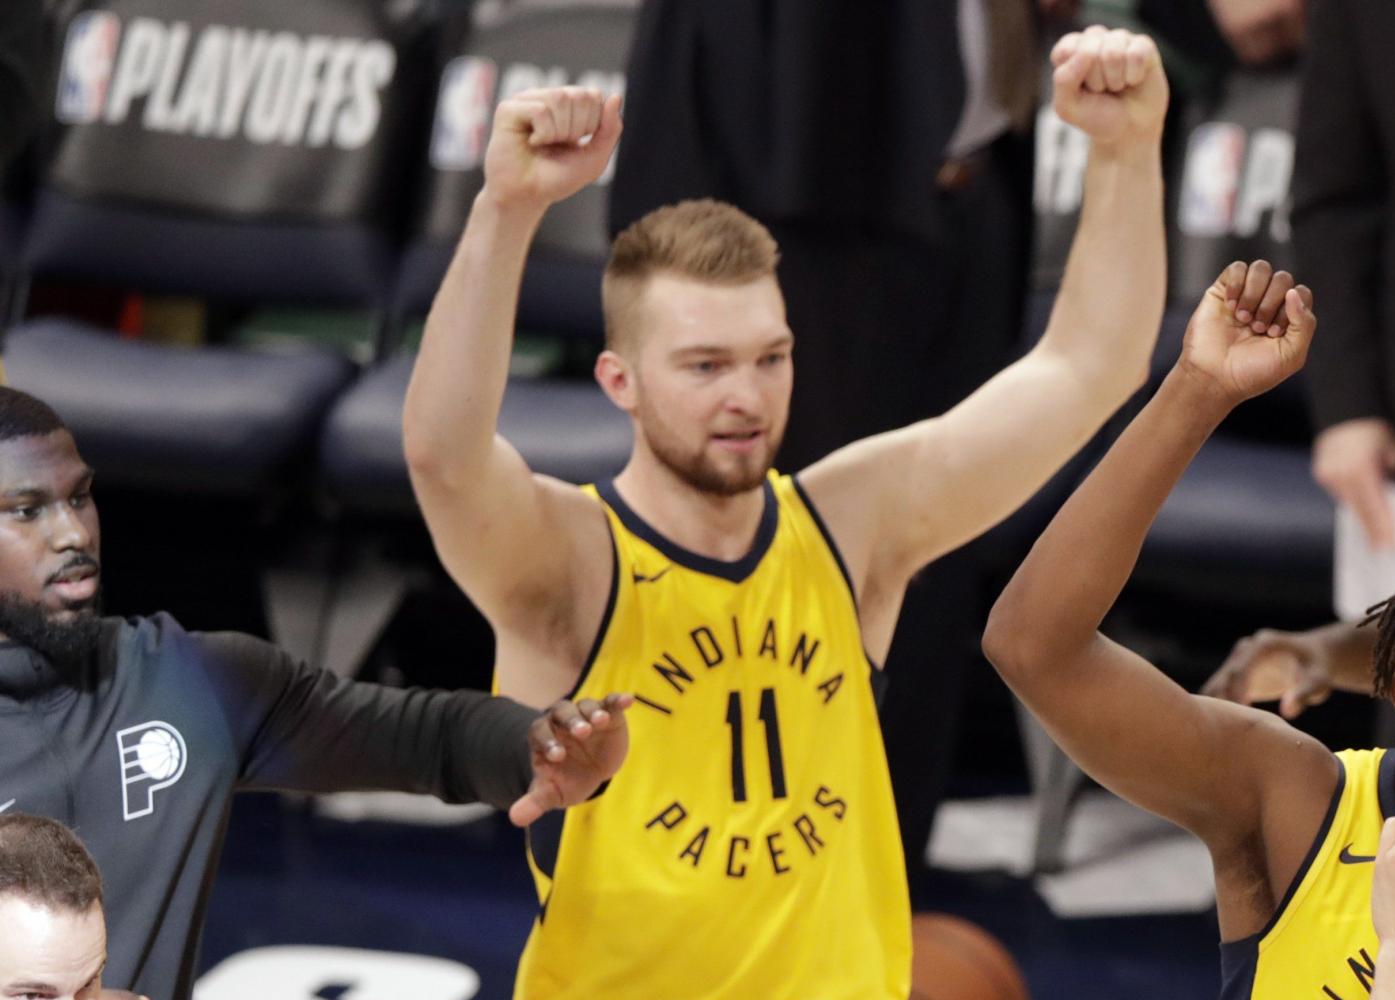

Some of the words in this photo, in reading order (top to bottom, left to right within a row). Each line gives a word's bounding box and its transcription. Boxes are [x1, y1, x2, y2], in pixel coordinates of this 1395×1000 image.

[103, 17, 397, 150] PLAYOFFS
[633, 616, 845, 717] INDIANA
[725, 688, 788, 804] 11
[646, 784, 849, 879] PACERS
